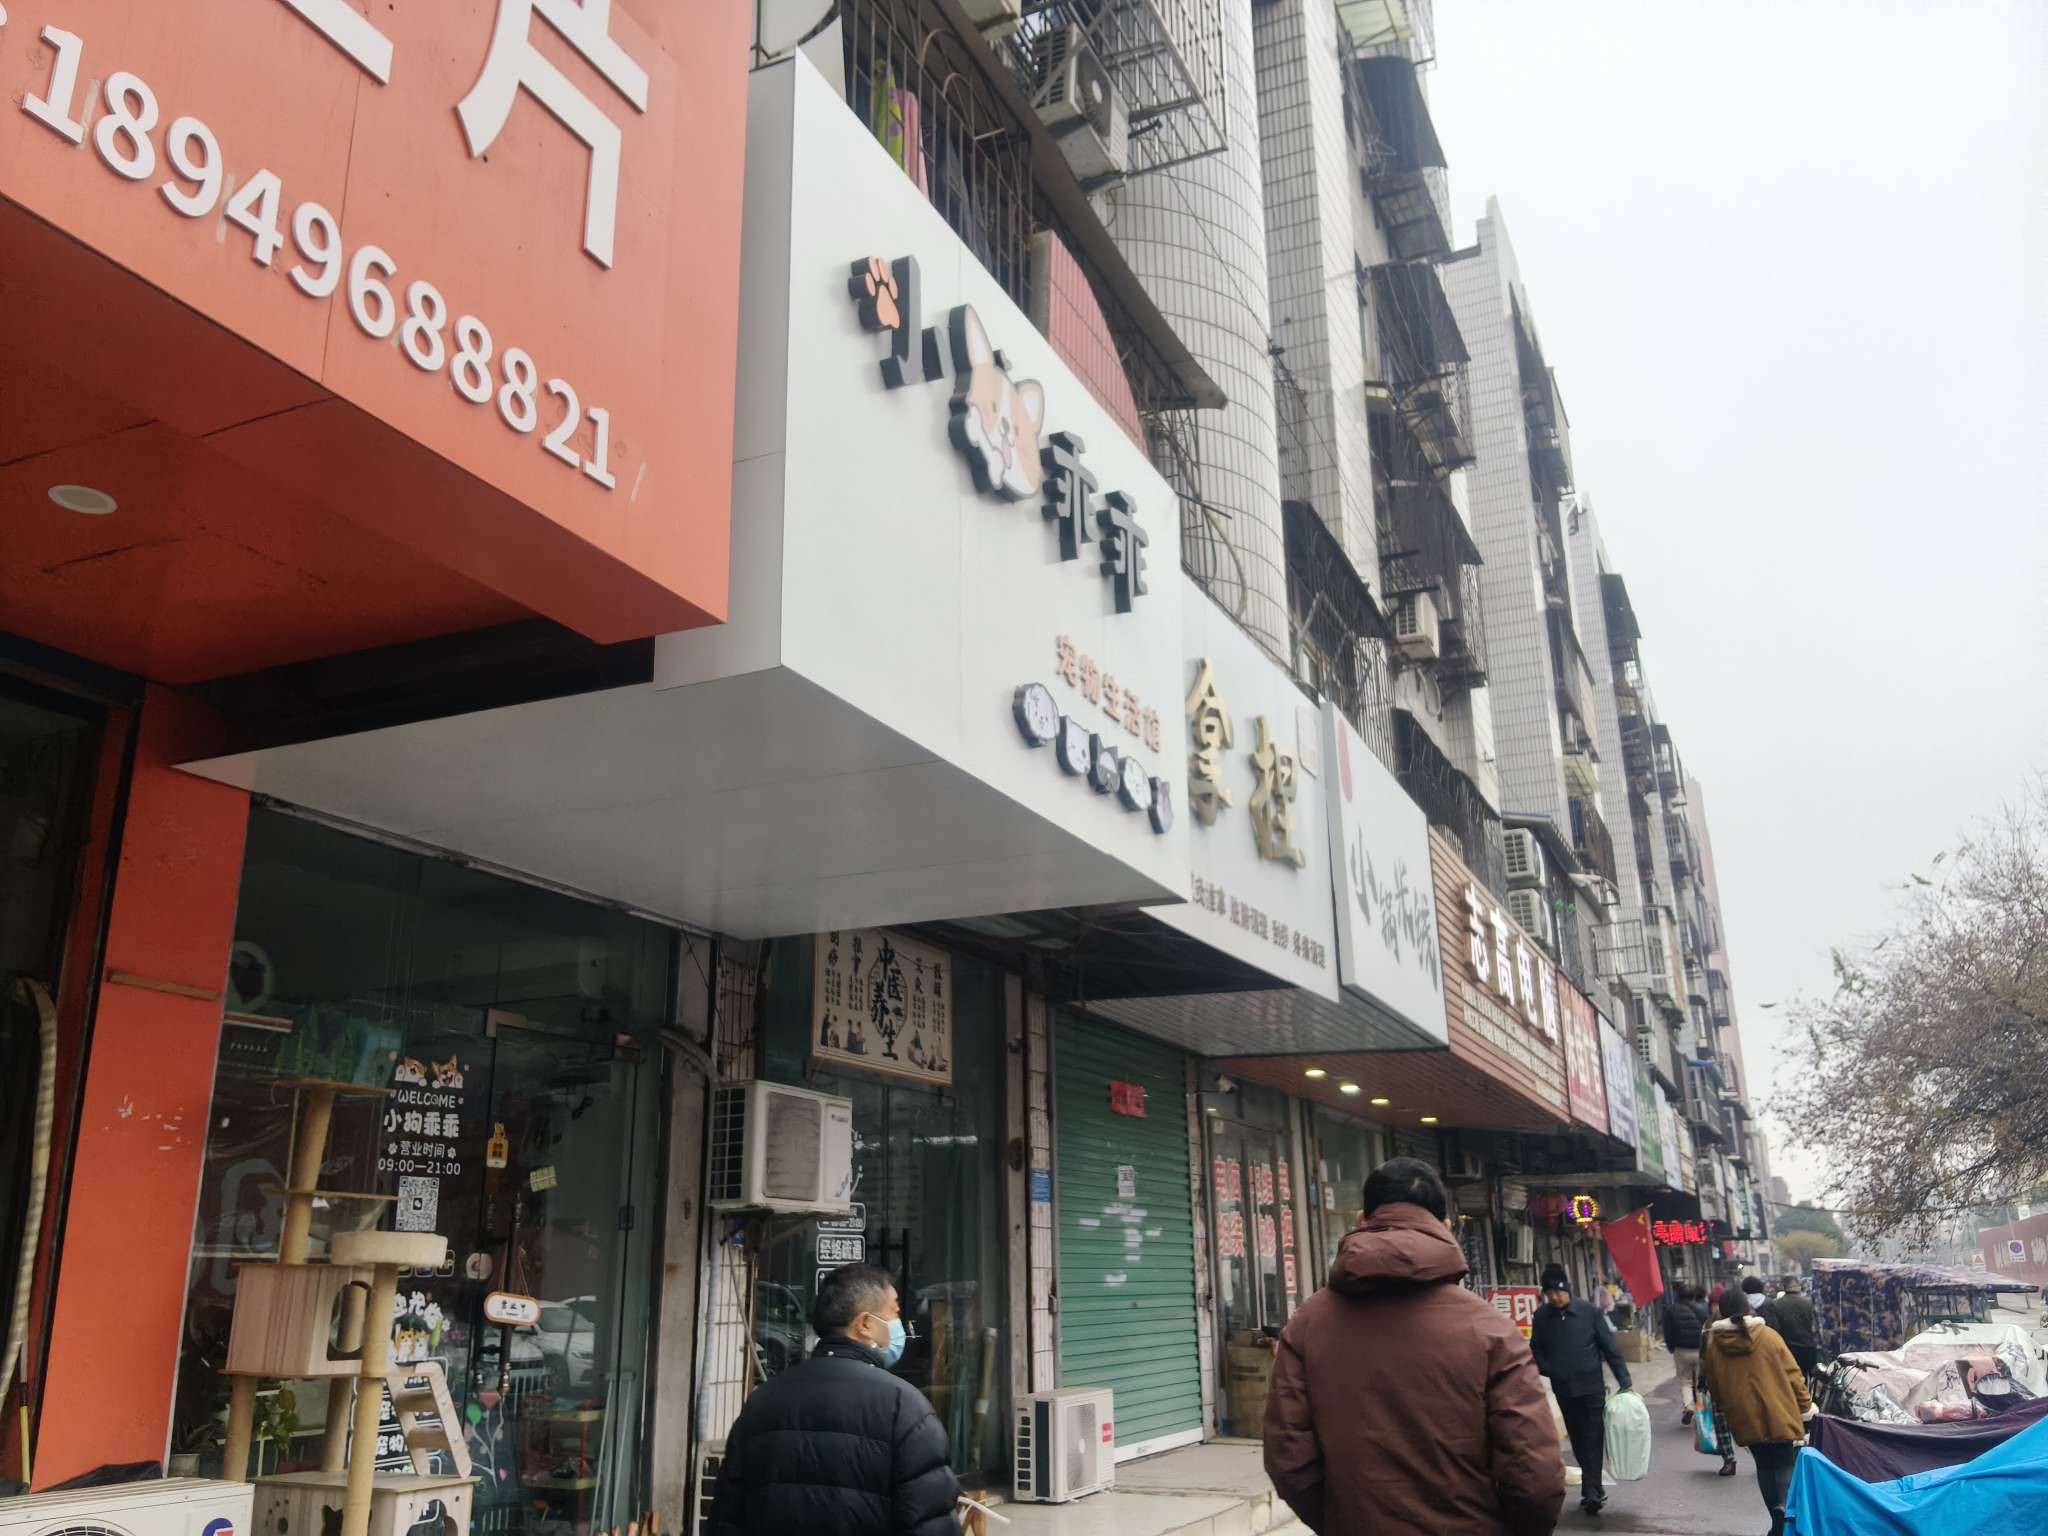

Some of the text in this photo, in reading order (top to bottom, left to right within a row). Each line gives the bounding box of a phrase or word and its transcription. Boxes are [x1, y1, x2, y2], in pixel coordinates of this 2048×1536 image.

[22, 25, 617, 491] 18949688821
[1055, 634, 1161, 754] 宠物生活馆
[1185, 655, 1307, 869] 拿捏
[871, 936, 904, 1061] 中医养生
[1464, 880, 1558, 1045] 志高电脑
[383, 1107, 460, 1139] 小狗乖乖
[397, 1089, 456, 1109] WELCOME
[400, 1140, 446, 1159] 营业时间
[819, 1238, 862, 1260] 经络疏通
